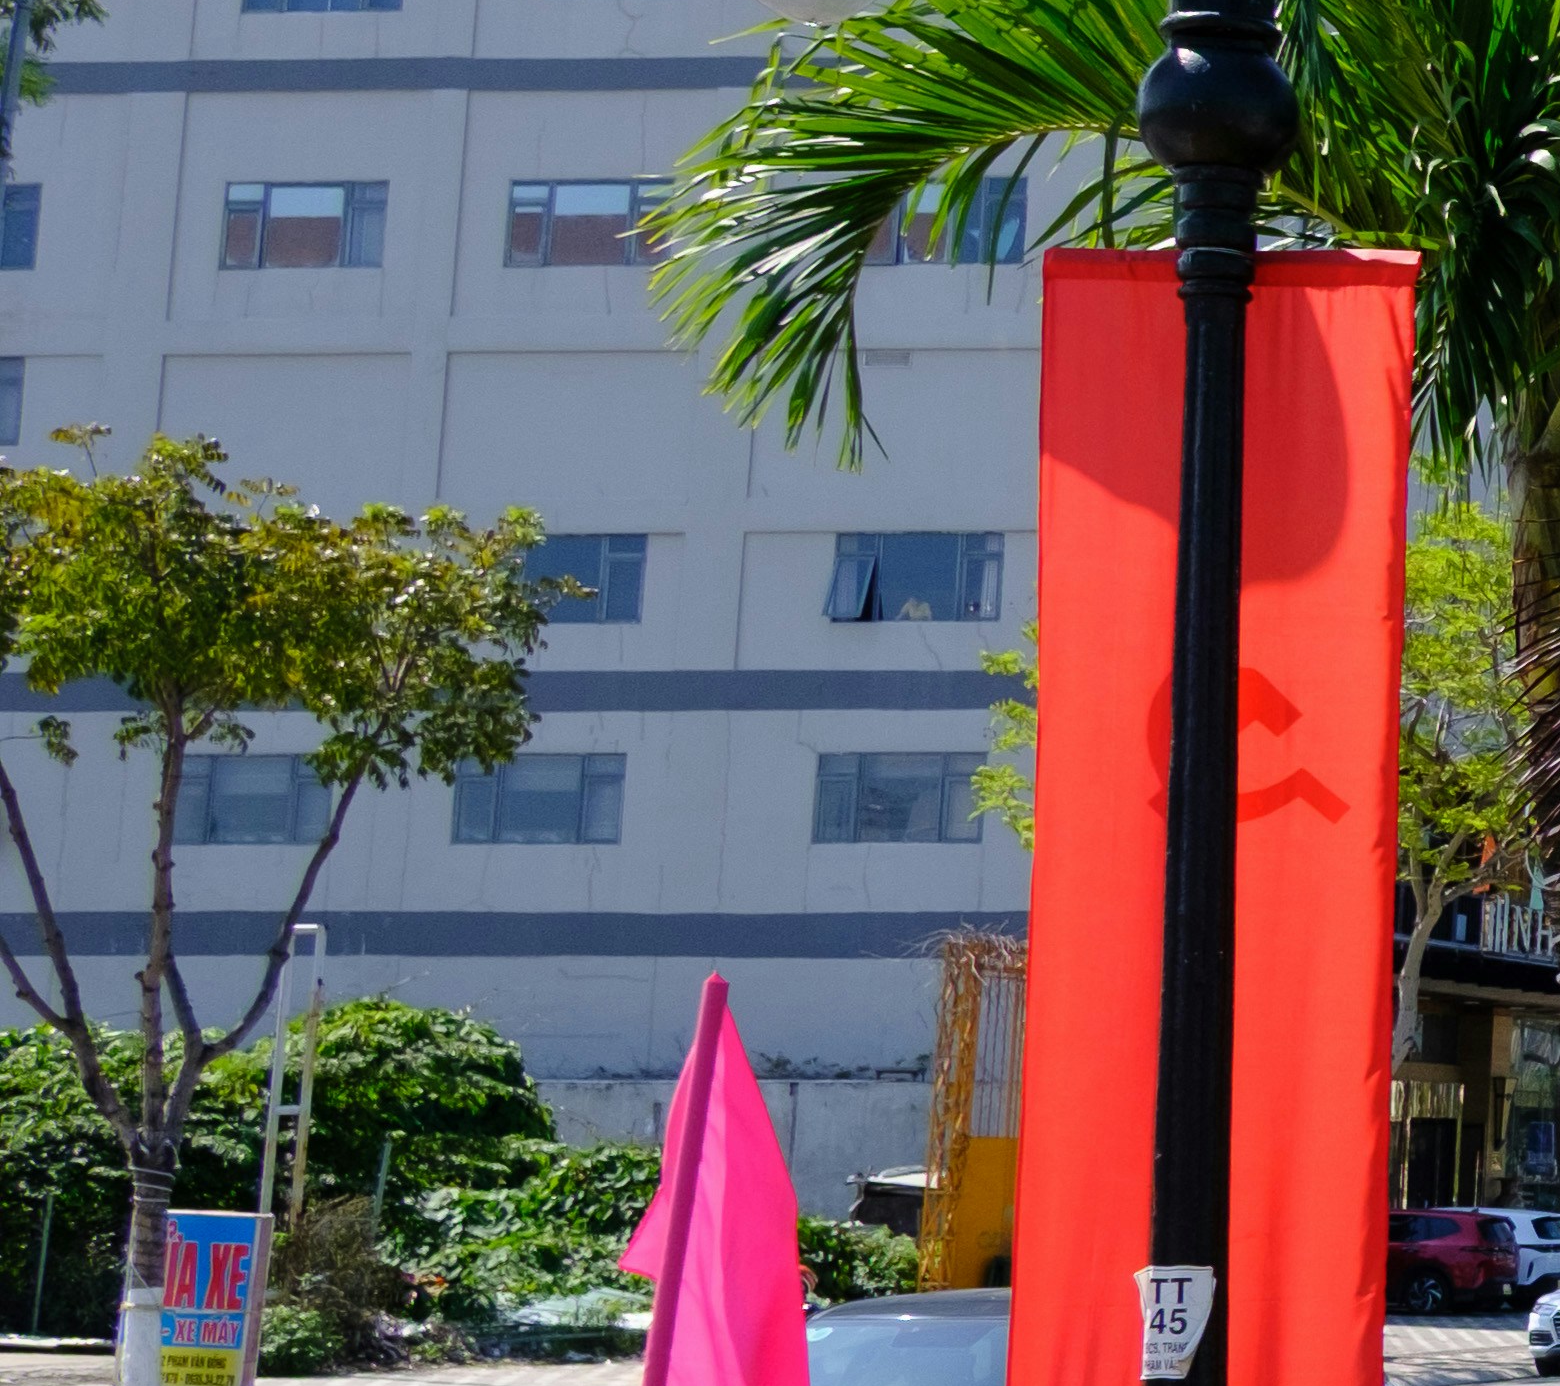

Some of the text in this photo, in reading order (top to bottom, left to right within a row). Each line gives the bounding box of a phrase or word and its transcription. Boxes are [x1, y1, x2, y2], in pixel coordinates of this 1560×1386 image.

[204, 1242, 250, 1311] XE
[1150, 1277, 1193, 1304] TT
[173, 1318, 199, 1343] XE
[201, 1315, 242, 1346] MÁY
[1150, 1308, 1188, 1334] 45
